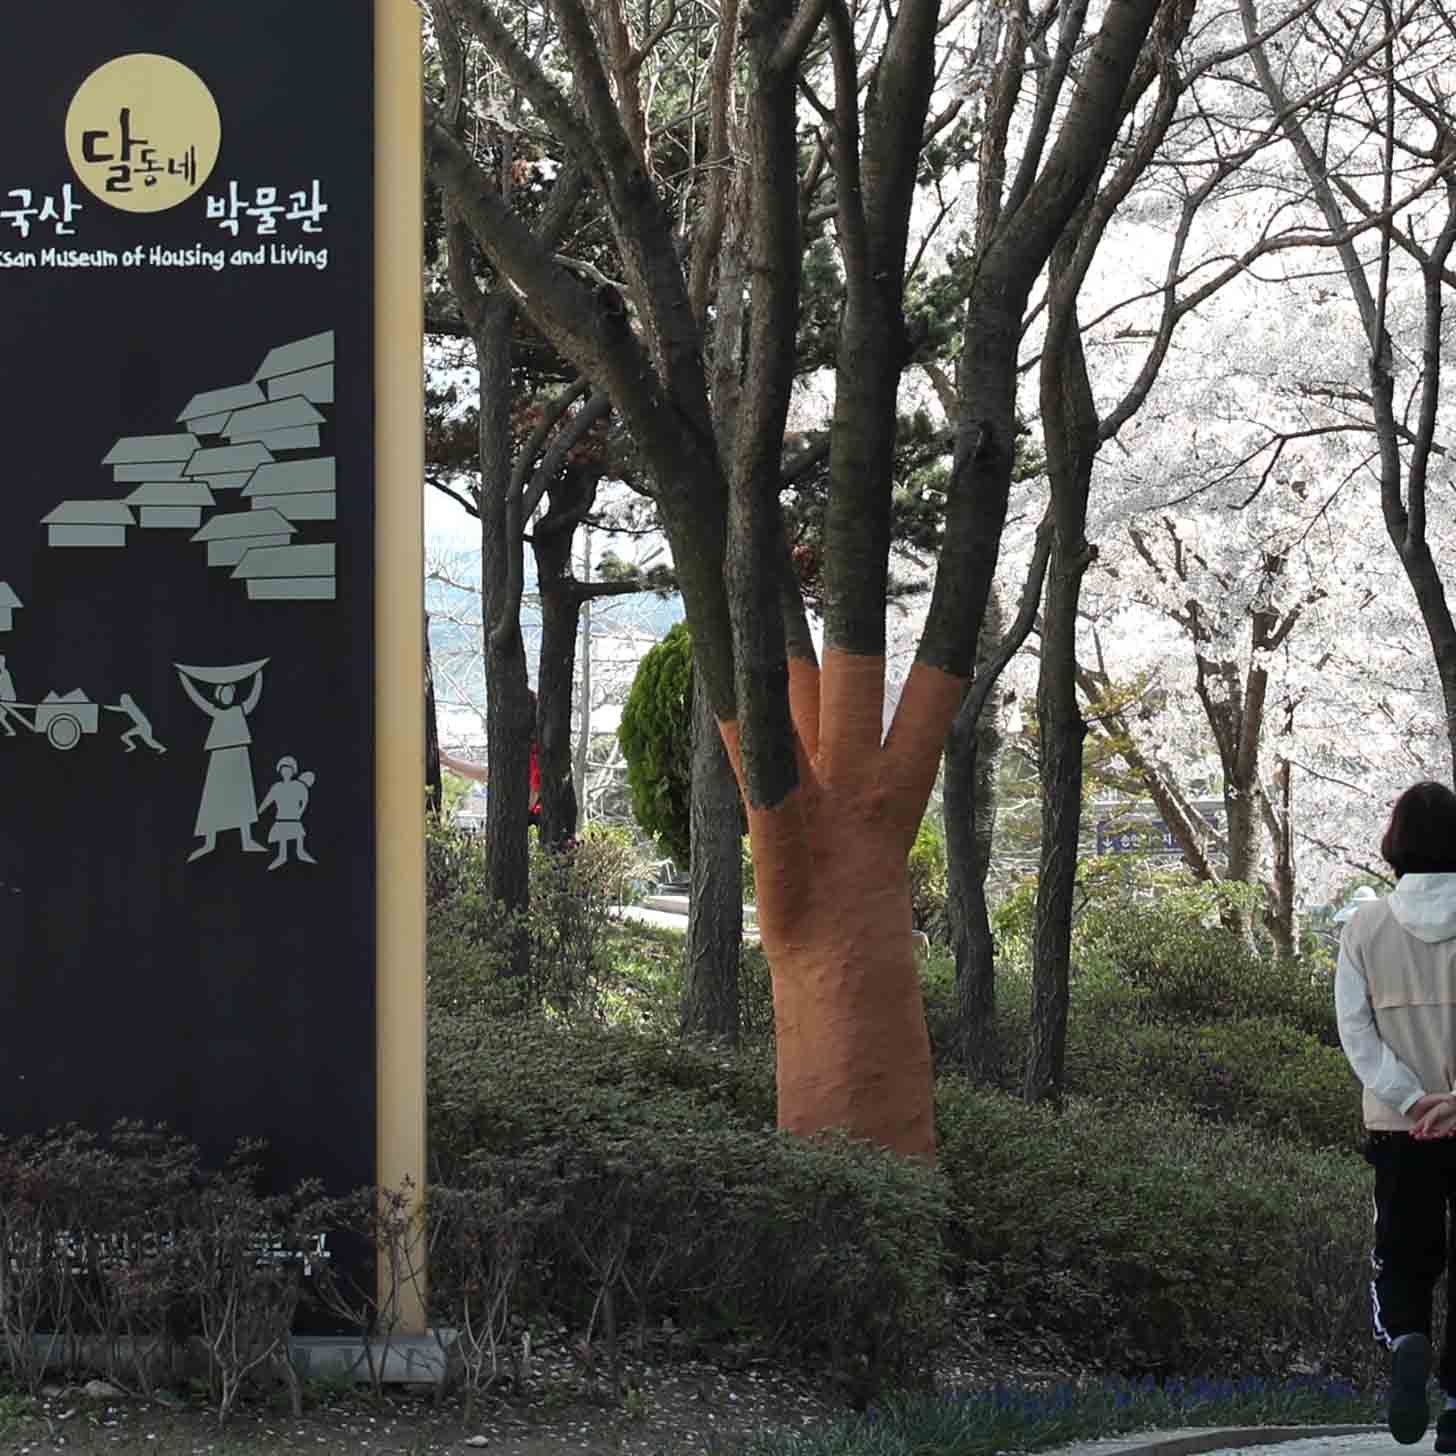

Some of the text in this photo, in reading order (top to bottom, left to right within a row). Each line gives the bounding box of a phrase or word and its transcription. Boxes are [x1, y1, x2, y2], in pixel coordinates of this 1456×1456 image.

[81, 107, 197, 193] 달동네
[206, 179, 328, 236] 박물관
[40, 247, 118, 268] Museum
[121, 245, 145, 267] of
[149, 243, 225, 272] Housing
[229, 245, 266, 266] and
[270, 244, 328, 270] Living
